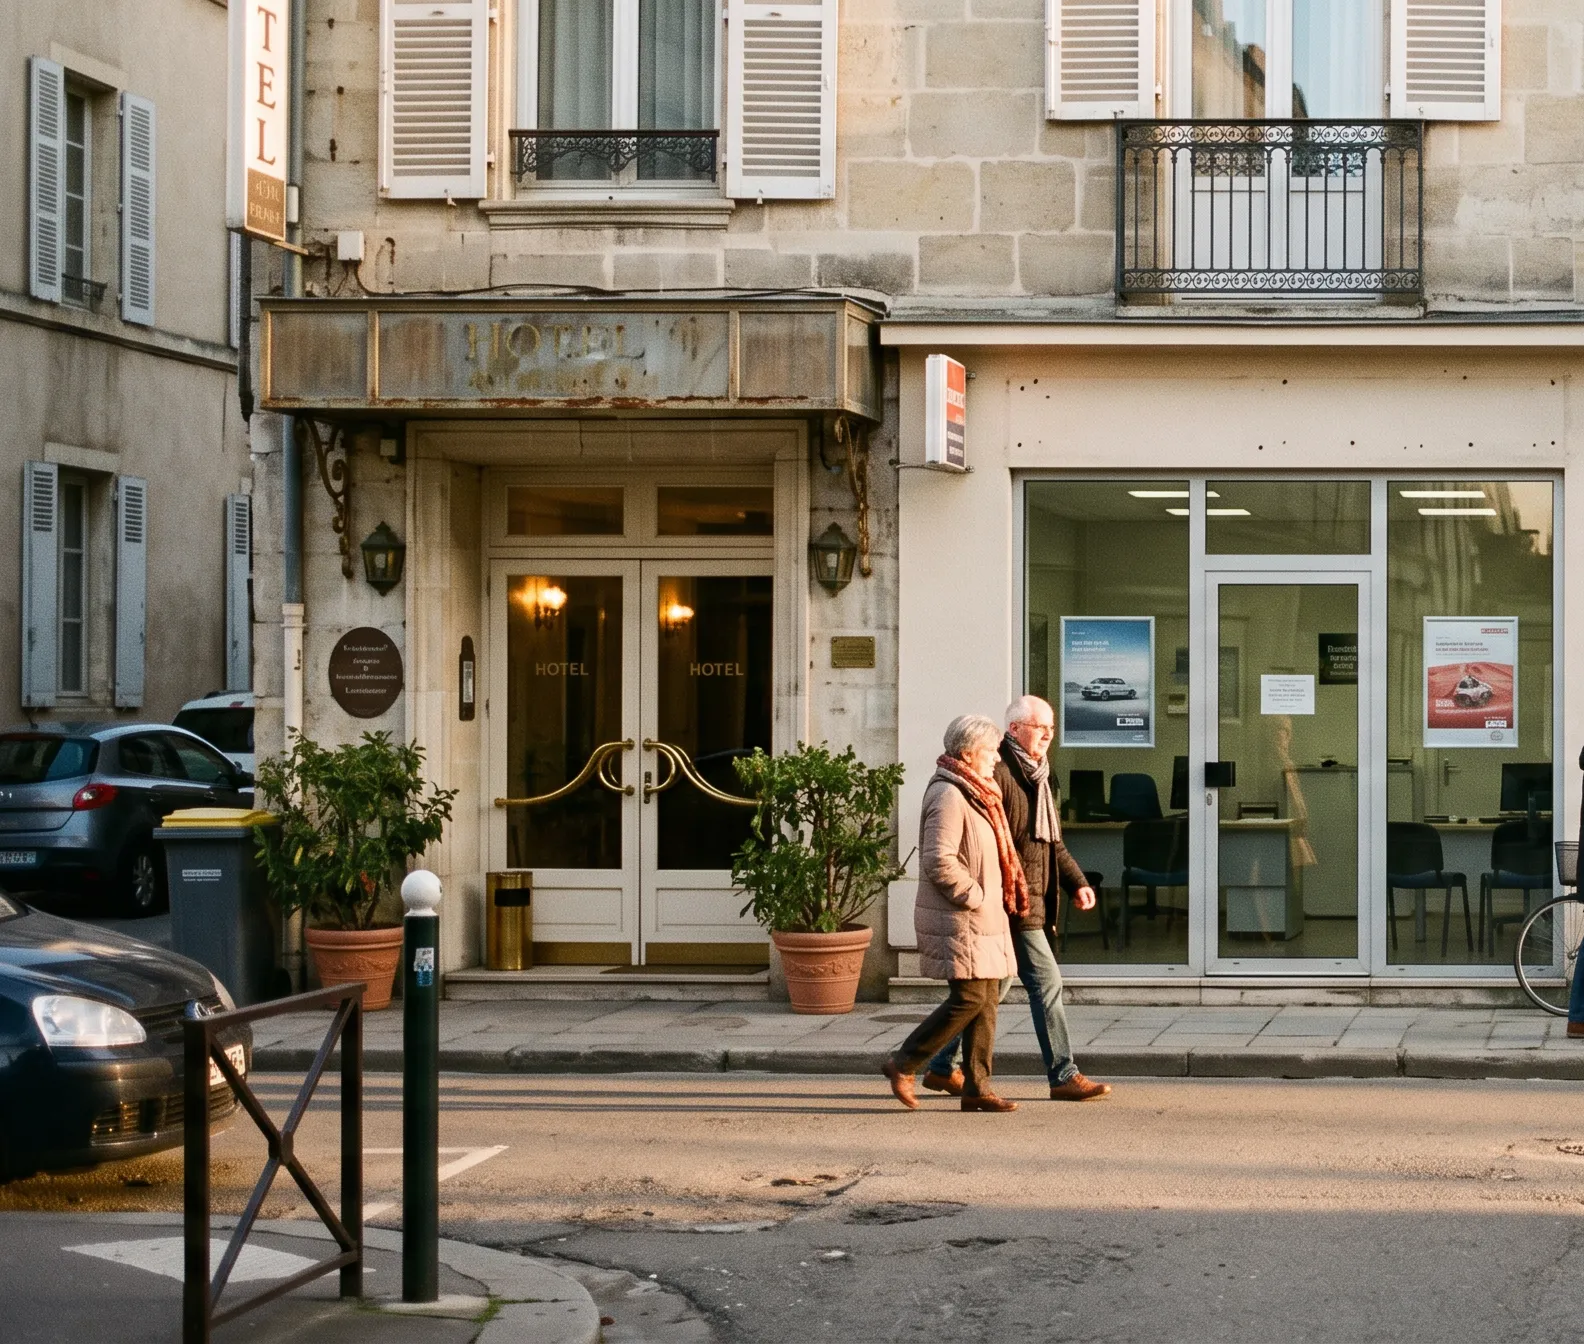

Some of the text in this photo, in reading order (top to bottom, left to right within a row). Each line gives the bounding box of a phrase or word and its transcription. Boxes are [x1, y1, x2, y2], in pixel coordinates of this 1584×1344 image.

[465, 322, 645, 360] HOTEL
[535, 662, 589, 676] HOTEL
[690, 662, 744, 676] HOTEL
